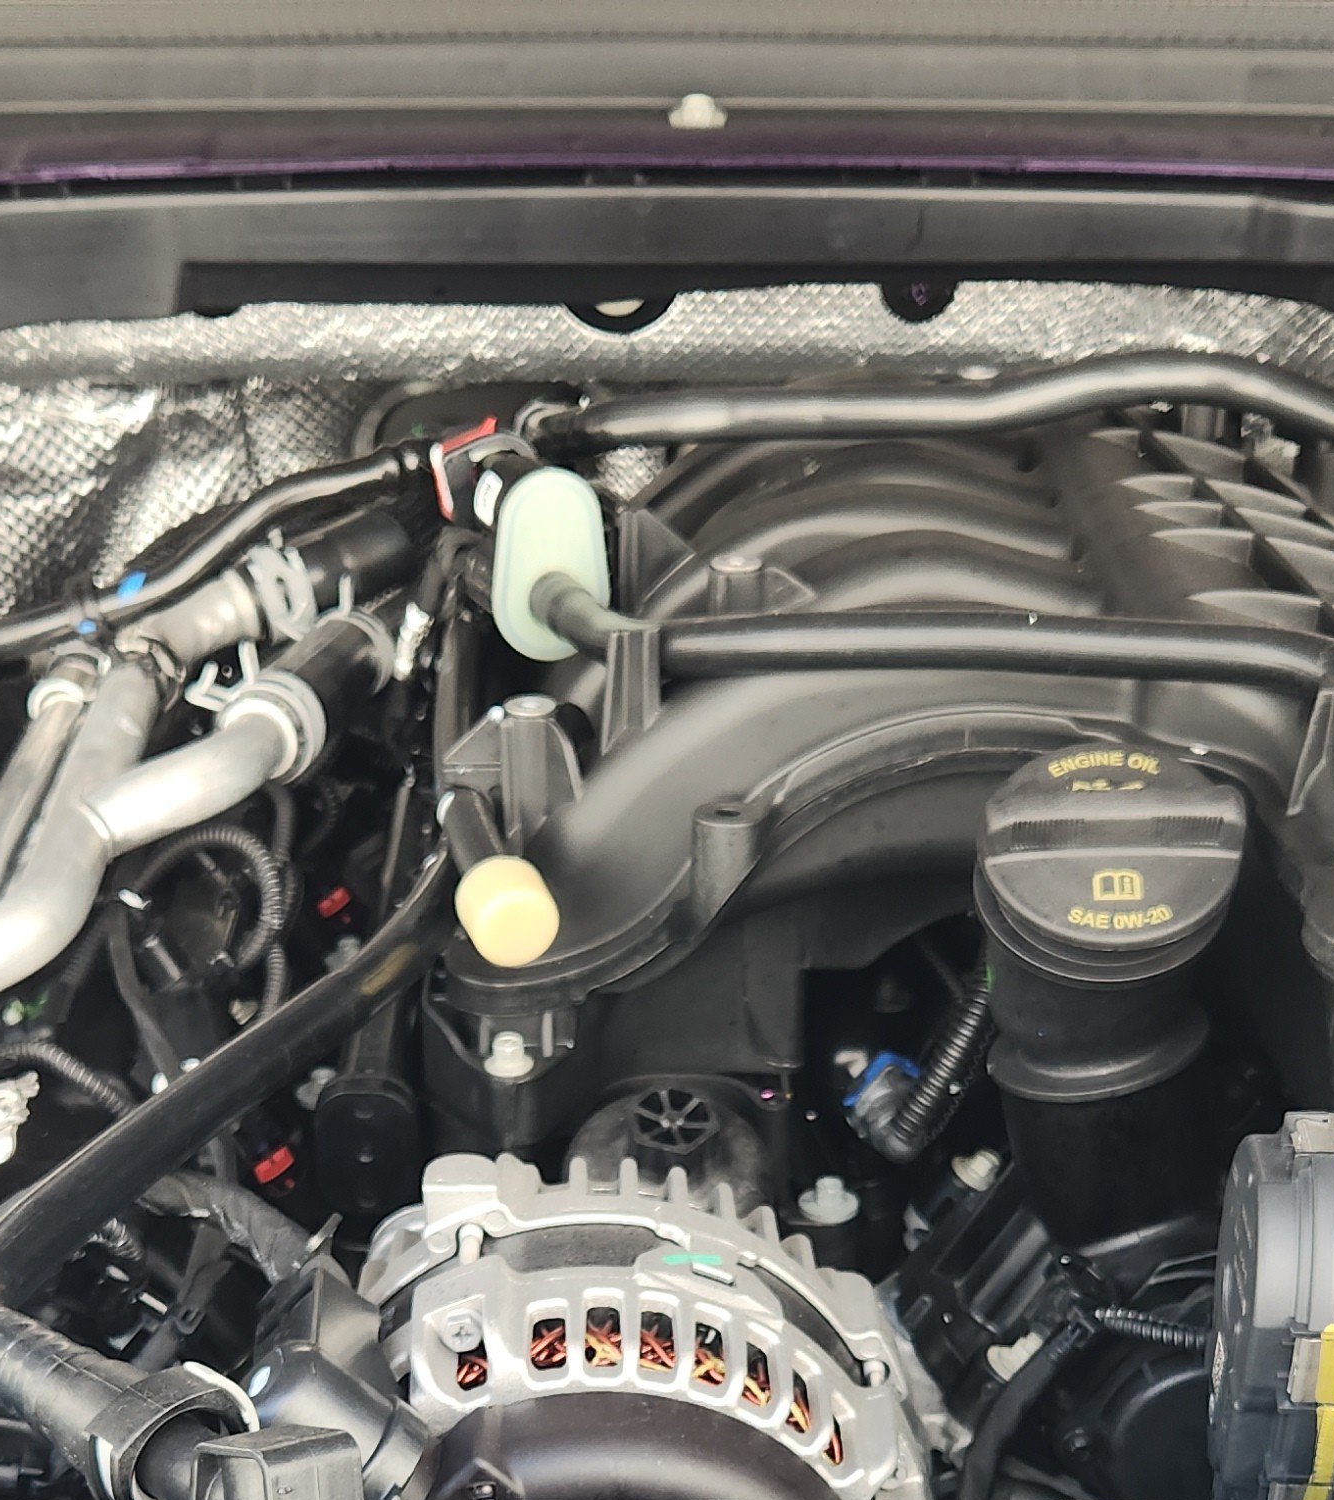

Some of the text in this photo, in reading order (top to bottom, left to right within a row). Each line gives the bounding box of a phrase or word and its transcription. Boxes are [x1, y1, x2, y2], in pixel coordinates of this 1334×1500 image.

[1047, 751, 1161, 779] ENGINE OIL
[1067, 903, 1175, 931] SAE 0W-20
